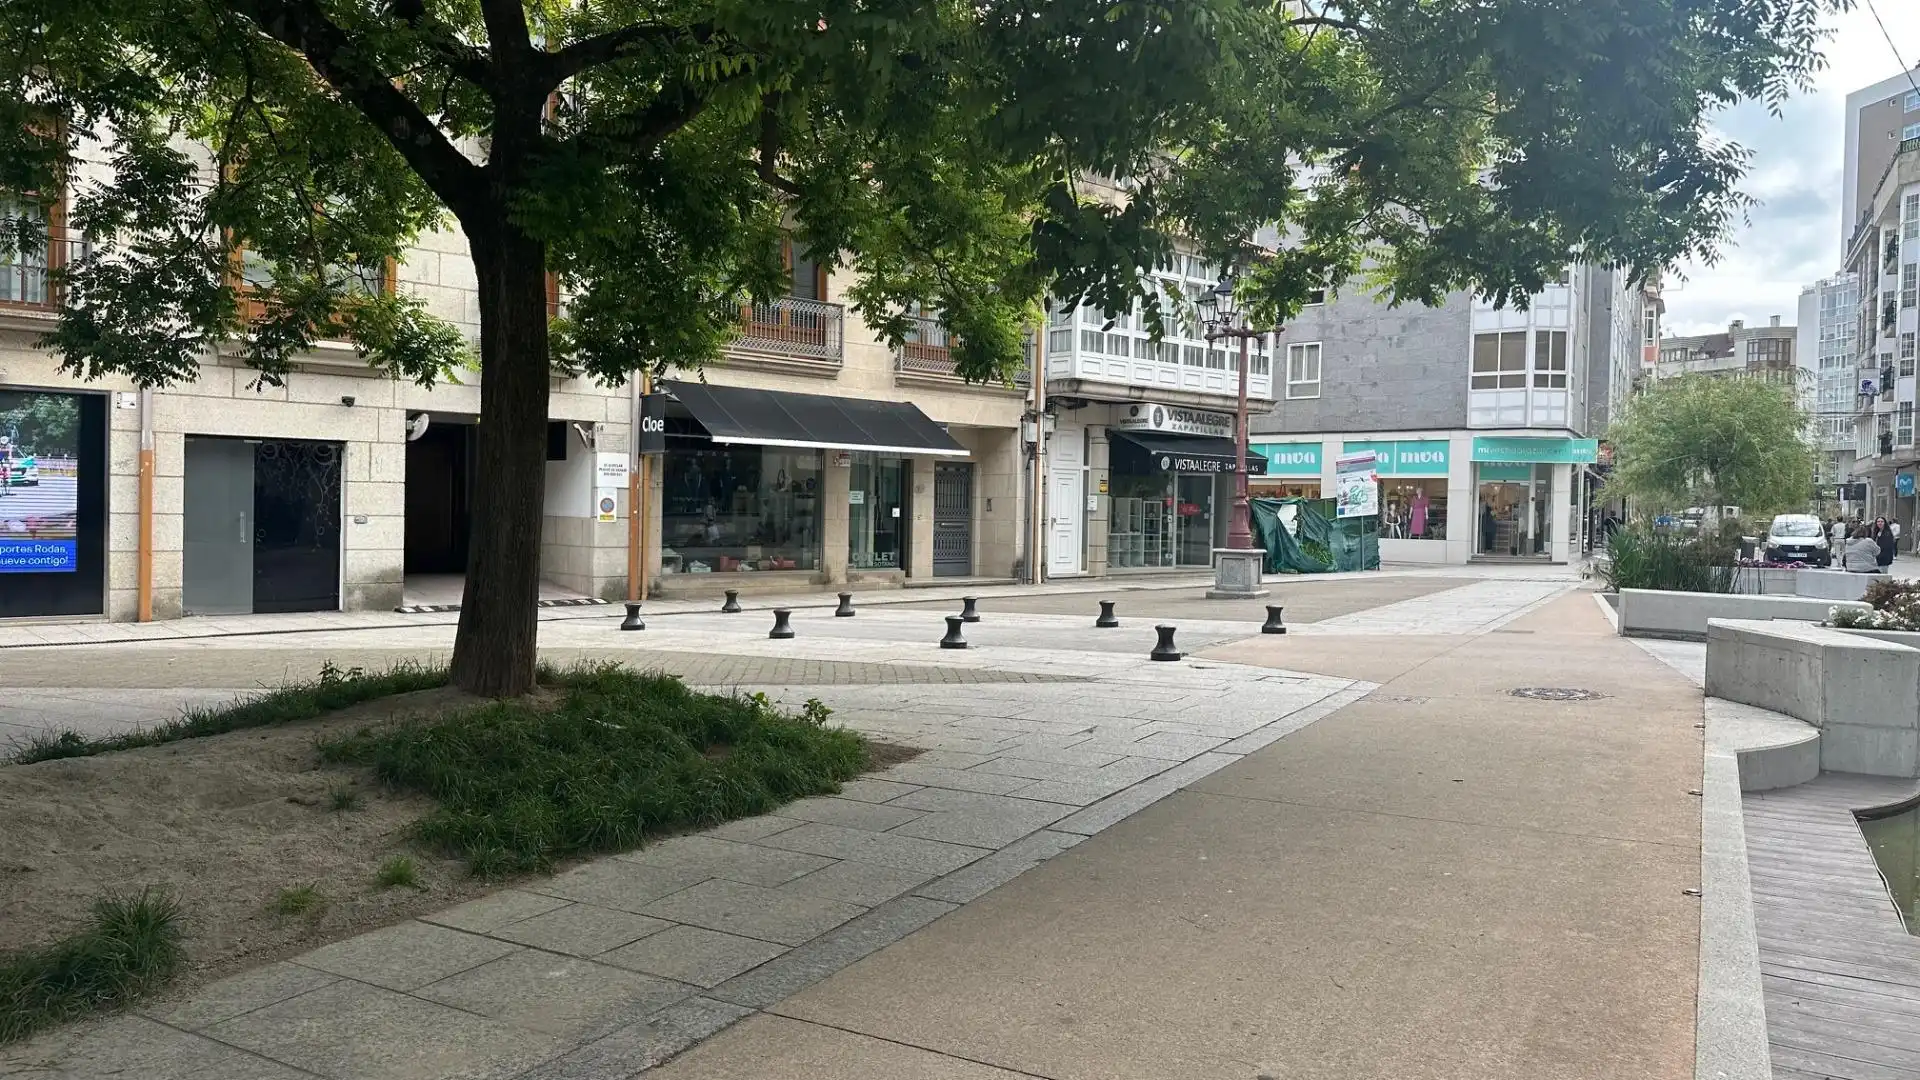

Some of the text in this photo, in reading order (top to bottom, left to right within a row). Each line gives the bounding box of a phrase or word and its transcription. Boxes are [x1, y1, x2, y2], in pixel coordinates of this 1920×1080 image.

[642, 416, 664, 432] Cloe
[1167, 408, 1230, 427] VISTAALEGRE
[1171, 423, 1224, 435] ZAPATILLAS
[1175, 458, 1220, 472] VISTAALEGRE
